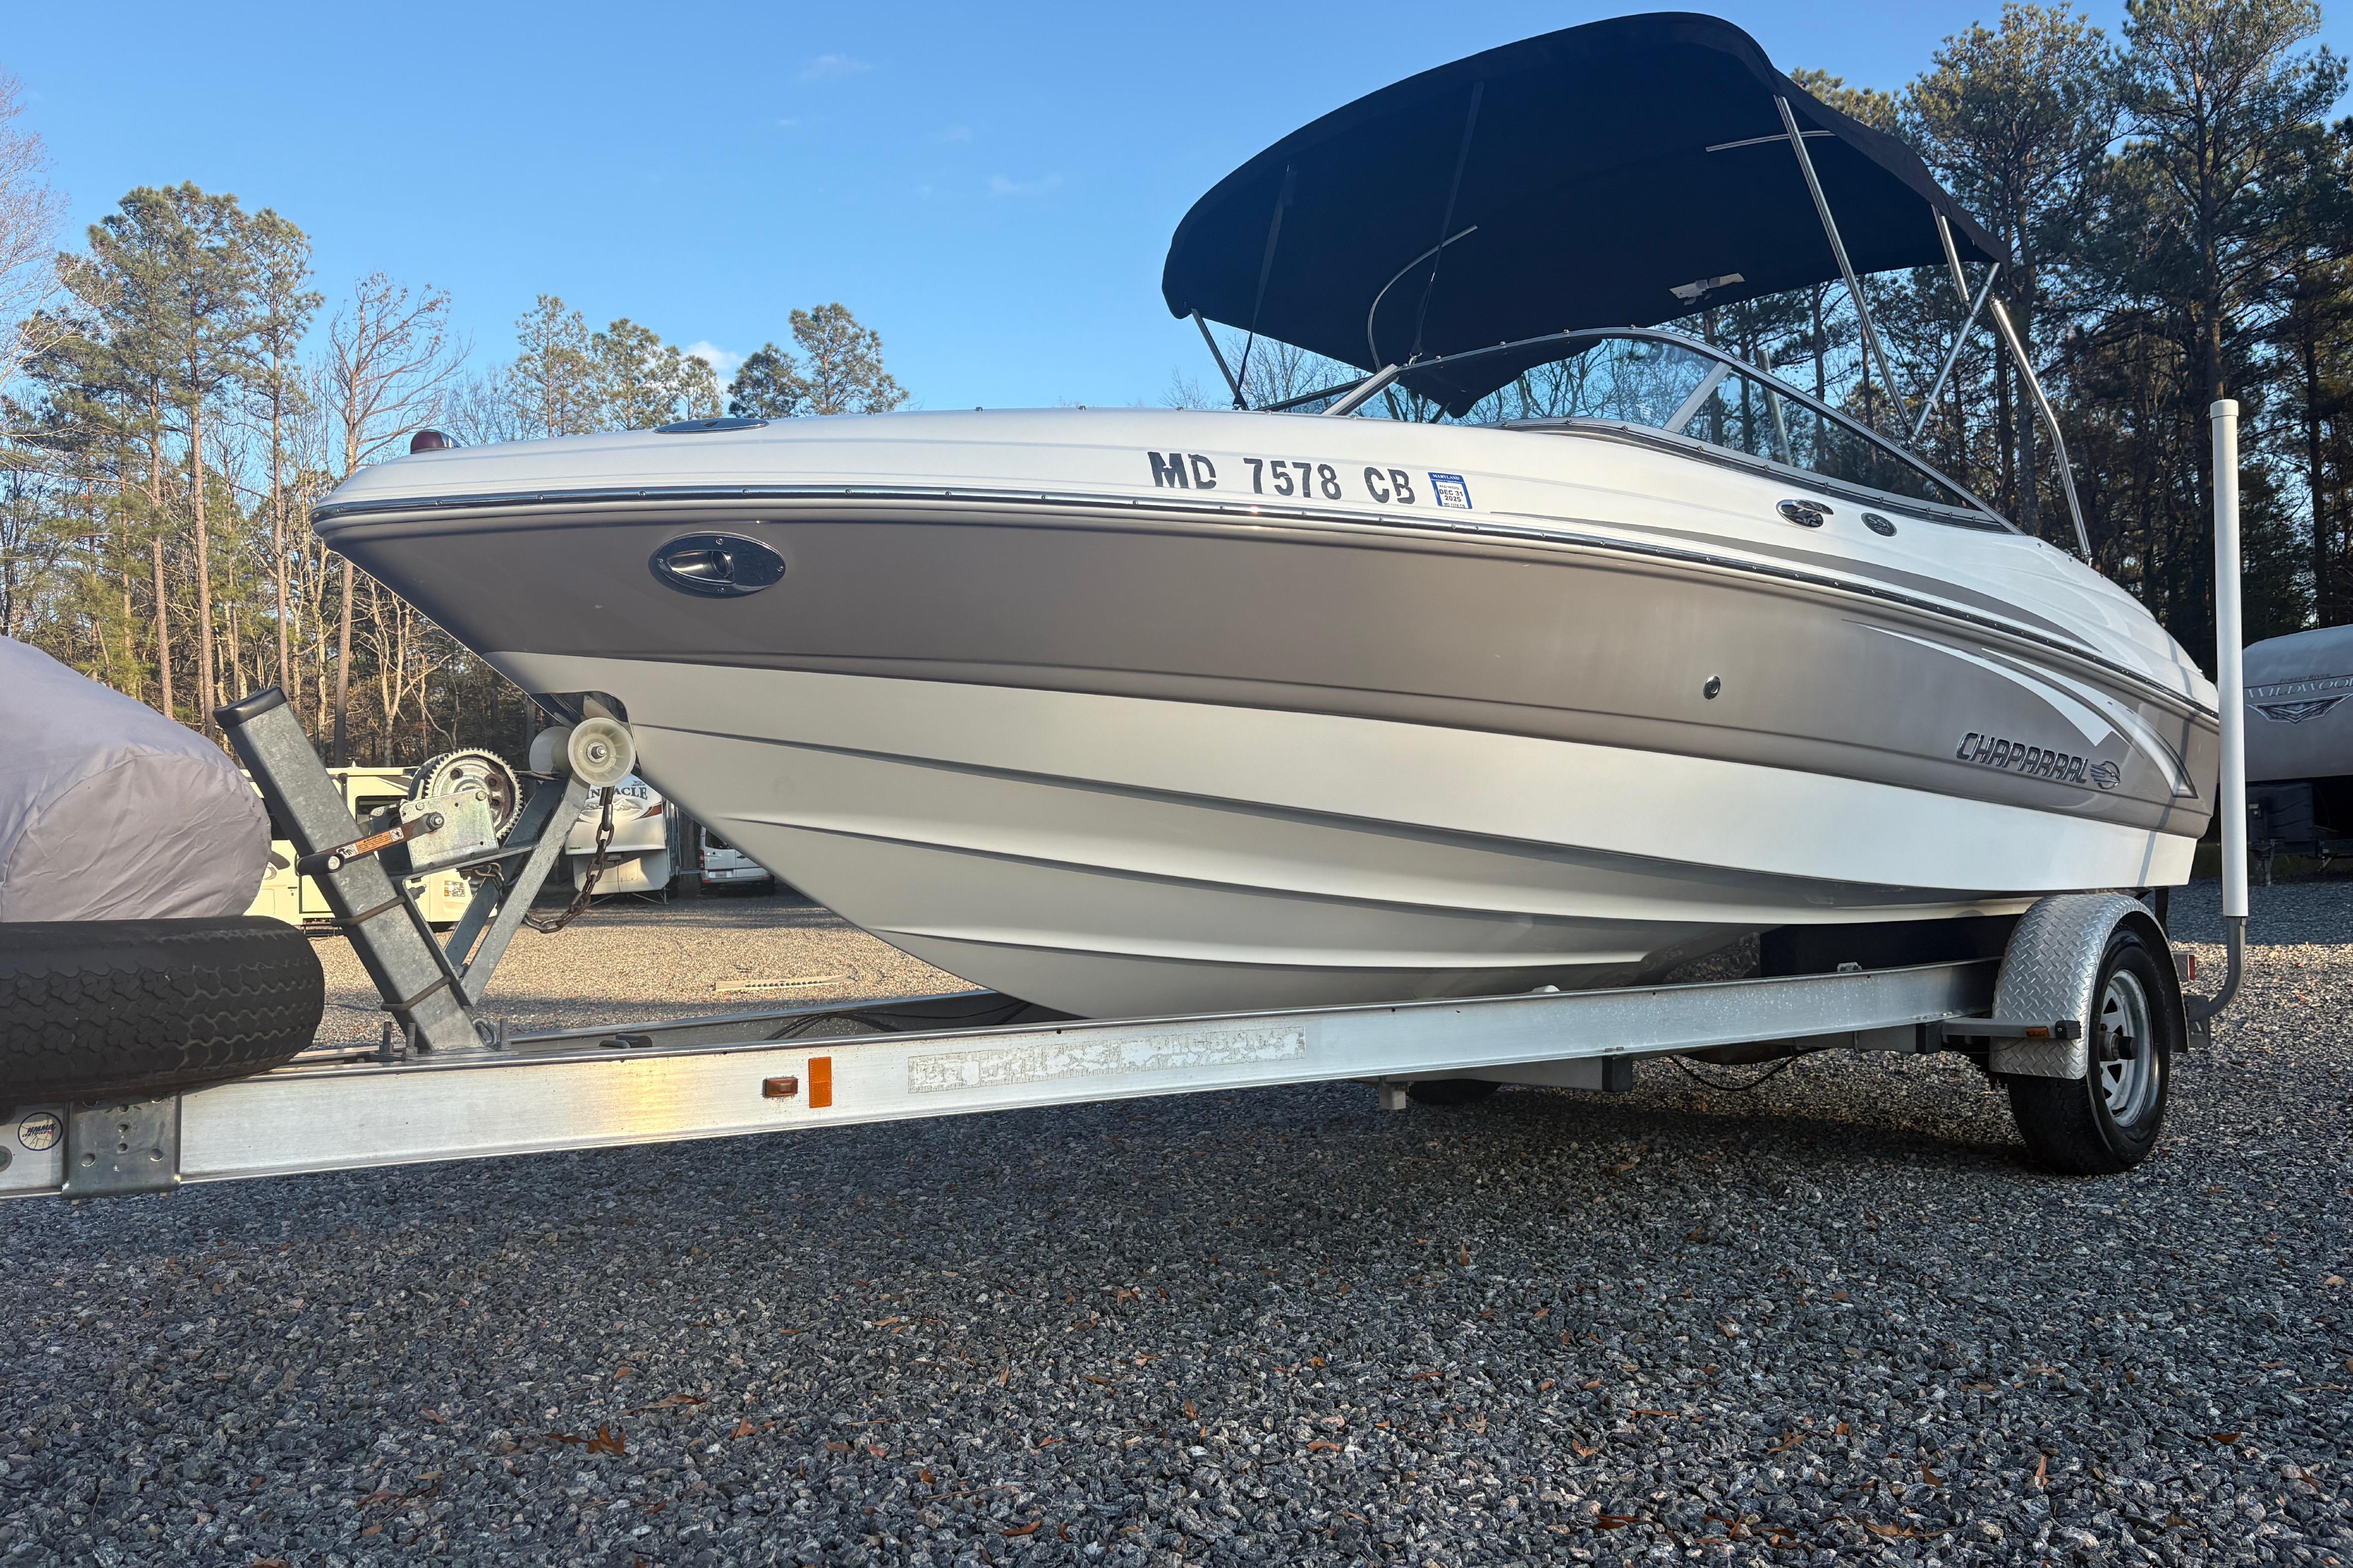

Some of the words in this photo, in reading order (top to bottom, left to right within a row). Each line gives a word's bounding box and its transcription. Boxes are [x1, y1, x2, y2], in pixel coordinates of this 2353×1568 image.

[1147, 451, 1217, 490] MD
[1244, 458, 1342, 500] 7578
[1364, 467, 1416, 504] CB
[1956, 732, 2089, 784] CHAPARRAL
